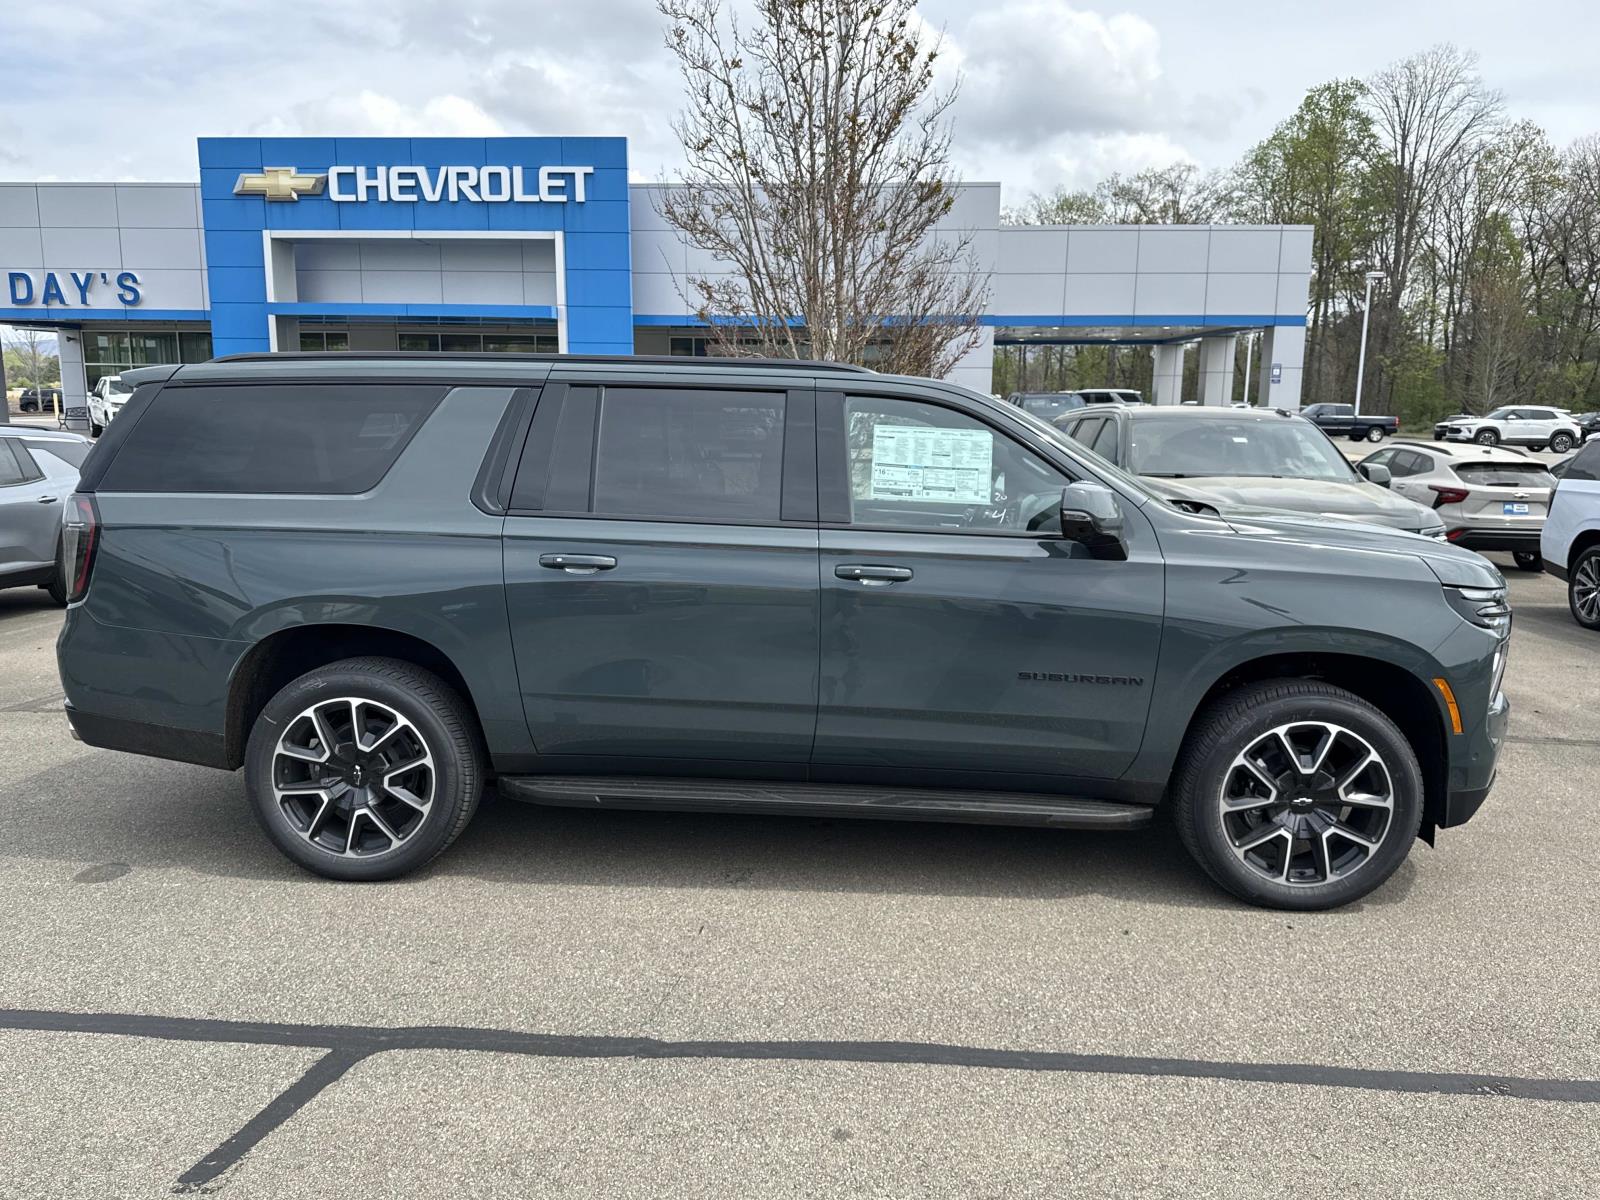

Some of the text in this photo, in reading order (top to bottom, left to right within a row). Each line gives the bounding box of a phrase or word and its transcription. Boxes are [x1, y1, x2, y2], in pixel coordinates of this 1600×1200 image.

[328, 165, 594, 203] CHEVROLET
[8, 272, 140, 305] DAY'S
[1017, 671, 1144, 687] SUBURBAN
